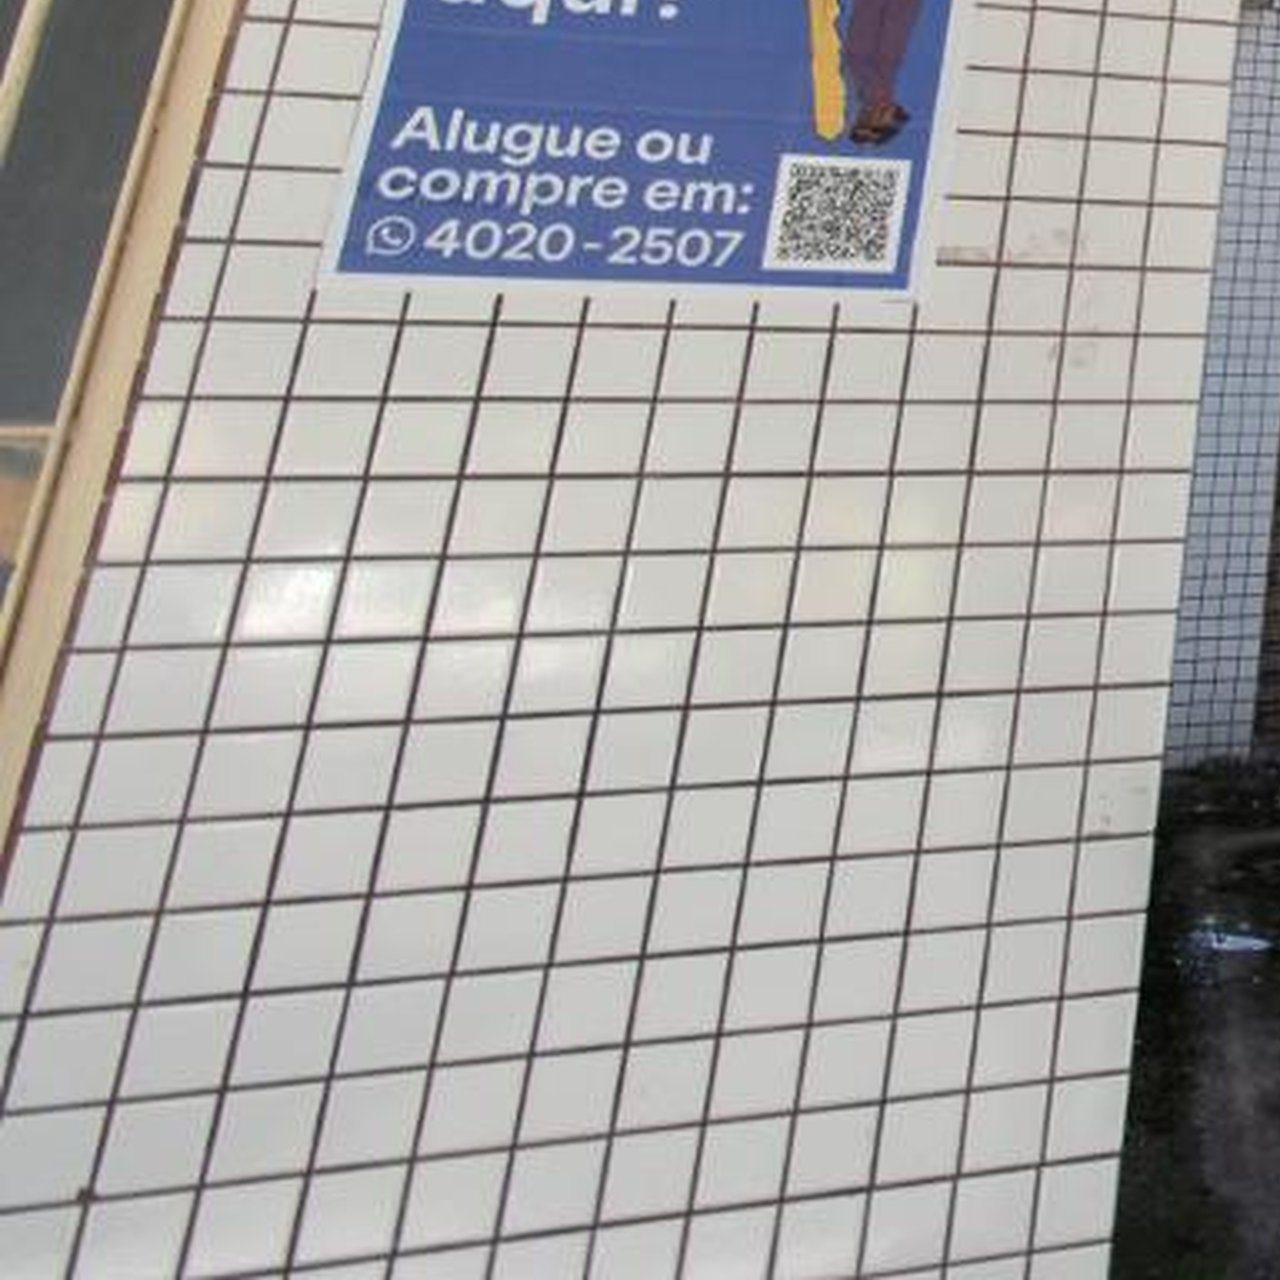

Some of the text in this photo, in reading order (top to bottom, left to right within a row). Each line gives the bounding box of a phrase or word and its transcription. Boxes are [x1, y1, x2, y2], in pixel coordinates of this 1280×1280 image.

[390, 105, 712, 167] Alugue ou
[377, 164, 755, 216] compre em:
